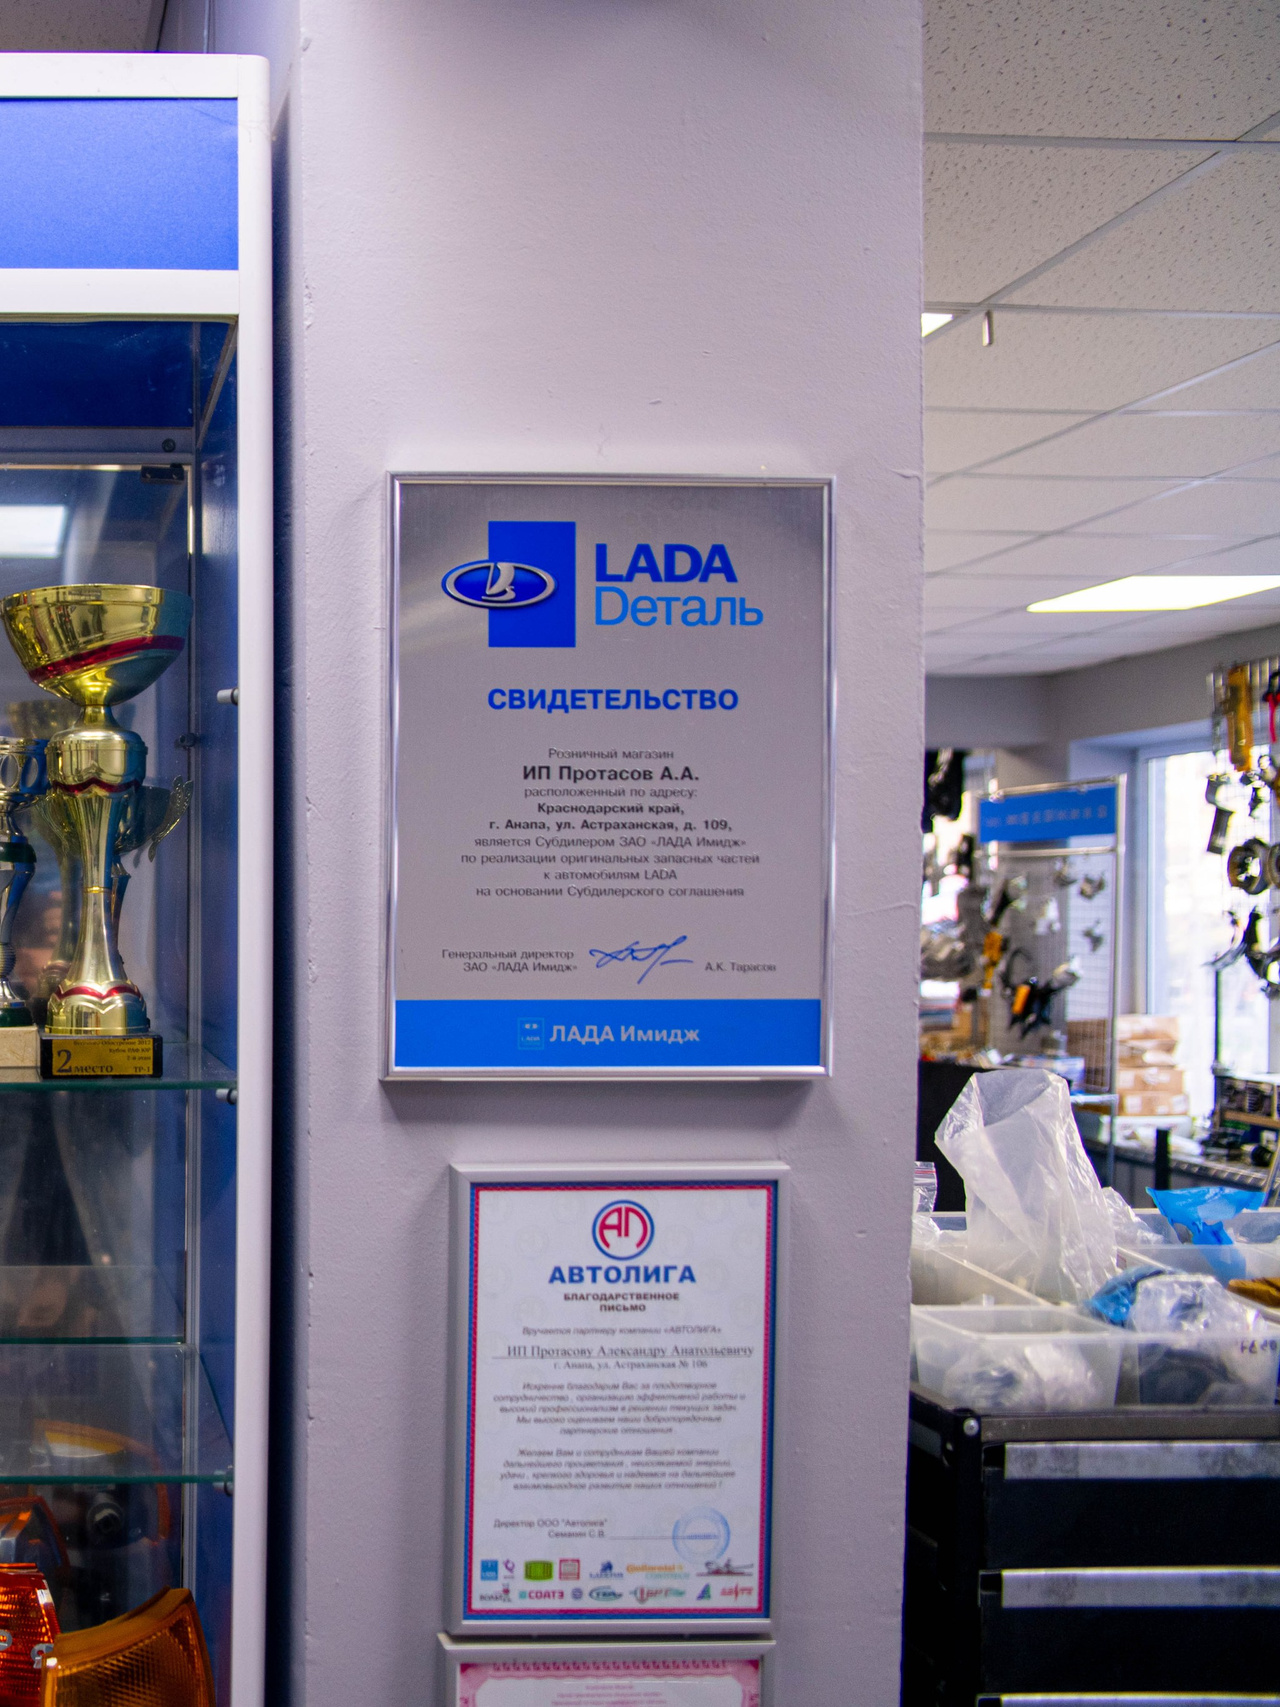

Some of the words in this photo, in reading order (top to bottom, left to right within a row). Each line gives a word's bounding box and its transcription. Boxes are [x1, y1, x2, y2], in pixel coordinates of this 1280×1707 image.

[595, 543, 738, 583] LADA
[488, 688, 739, 714] СВИДЕТЕЛЬСТВО
[548, 747, 618, 759] Розничный
[622, 749, 674, 759] магазин
[523, 766, 550, 781] ИП
[559, 766, 653, 784] Протасов
[660, 766, 700, 781] А.А.
[524, 785, 626, 799] расположенный
[629, 788, 646, 798] по
[649, 788, 698, 800] адресу:
[537, 802, 644, 816] Краснодарский
[648, 802, 685, 816] край,
[505, 820, 551, 832] Анапа,
[555, 821, 576, 833] ул.
[580, 820, 678, 832] Астраханская,
[683, 821, 697, 833] д.
[703, 820, 733, 832] 109,
[474, 837, 531, 848] является
[535, 836, 615, 850] Субдилером
[619, 836, 647, 848] ЗАО
[461, 854, 477, 864] по
[481, 853, 556, 866] реализации
[560, 853, 650, 866] оригинальных
[654, 853, 713, 864] запасных
[717, 852, 760, 864] частей
[554, 868, 640, 881] автомобилям
[644, 868, 678, 881] LADA
[476, 887, 492, 897] на
[495, 886, 563, 897] основании
[567, 884, 665, 898] Субдилерского
[668, 886, 745, 897] соглашения
[442, 948, 518, 960] Генеральный
[521, 950, 574, 962] директор
[463, 962, 489, 973] ЗАО
[730, 962, 777, 975] Тарасов
[549, 1025, 615, 1045] ЛАДА
[620, 1025, 700, 1045] Имидж
[56, 1049, 73, 1073] 2
[74, 1065, 114, 1073] место
[548, 1265, 697, 1284] АВТОЛИГА
[563, 1292, 680, 1303] БЛАГОДАРСТВЕННОЕ
[599, 1303, 647, 1313] ПИСЬМО
[530, 1344, 593, 1359] Протасову
[597, 1344, 667, 1359] Александру
[672, 1343, 754, 1358] Анатольевичу
